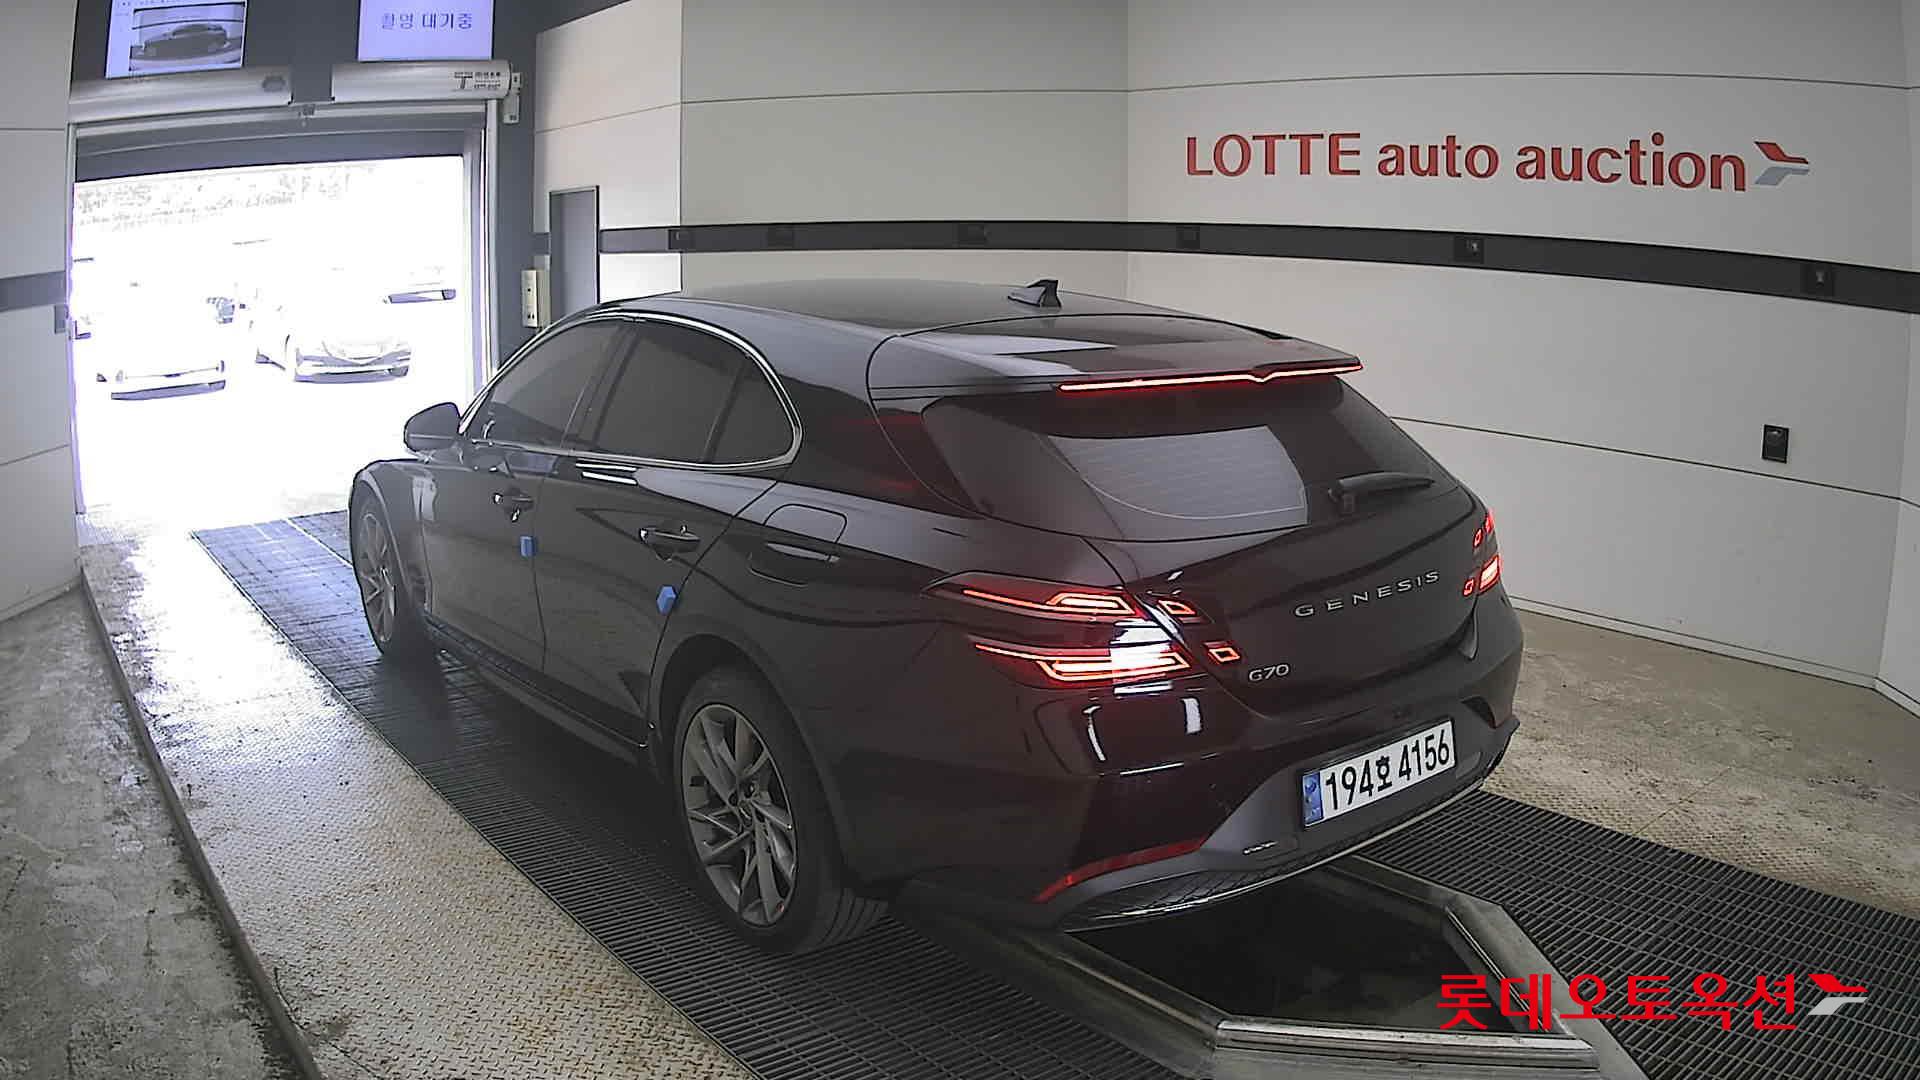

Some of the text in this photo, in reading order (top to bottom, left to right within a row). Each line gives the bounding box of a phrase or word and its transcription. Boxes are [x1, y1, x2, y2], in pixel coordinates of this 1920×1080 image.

[1186, 132, 1747, 192] LOTTE auto auction
[1295, 570, 1440, 617] GENESIS
[1248, 663, 1290, 682] G70
[1325, 729, 1450, 811] 194호 4156
